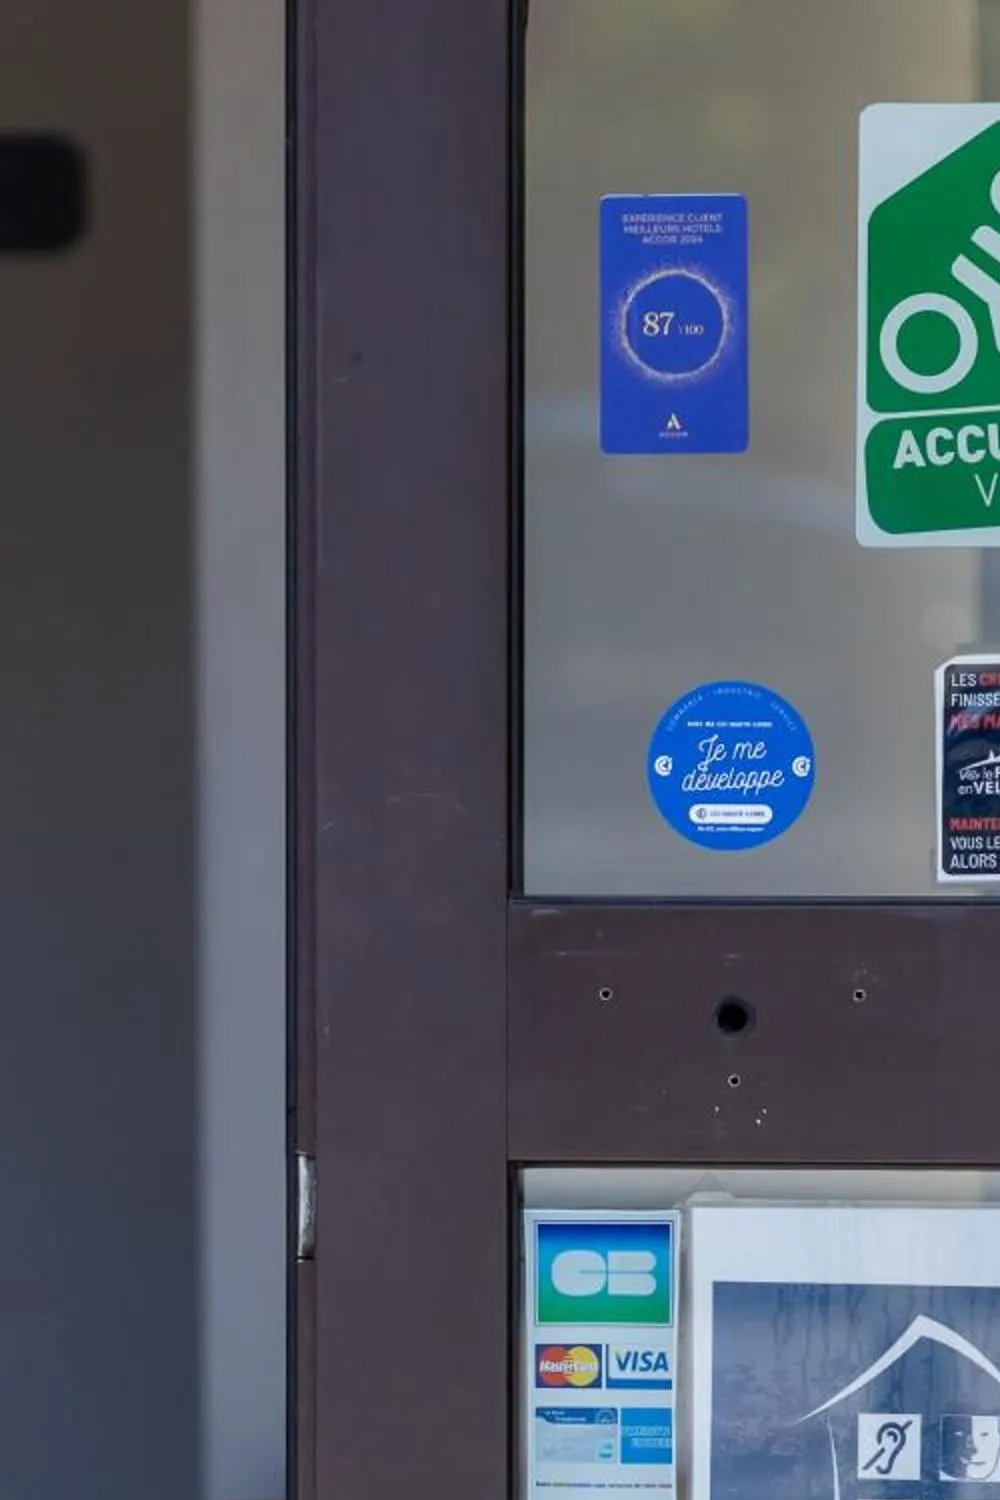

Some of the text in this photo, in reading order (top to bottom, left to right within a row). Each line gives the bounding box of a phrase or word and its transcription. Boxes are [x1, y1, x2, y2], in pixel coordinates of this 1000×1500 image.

[643, 311, 675, 336] 87
[951, 672, 977, 687] LES
[950, 714, 979, 729] MES
[698, 734, 768, 771] Je me
[950, 836, 982, 850] VOUS
[950, 853, 997, 869] ALORS
[551, 1249, 657, 1297] CB
[615, 1350, 669, 1373] VISA
